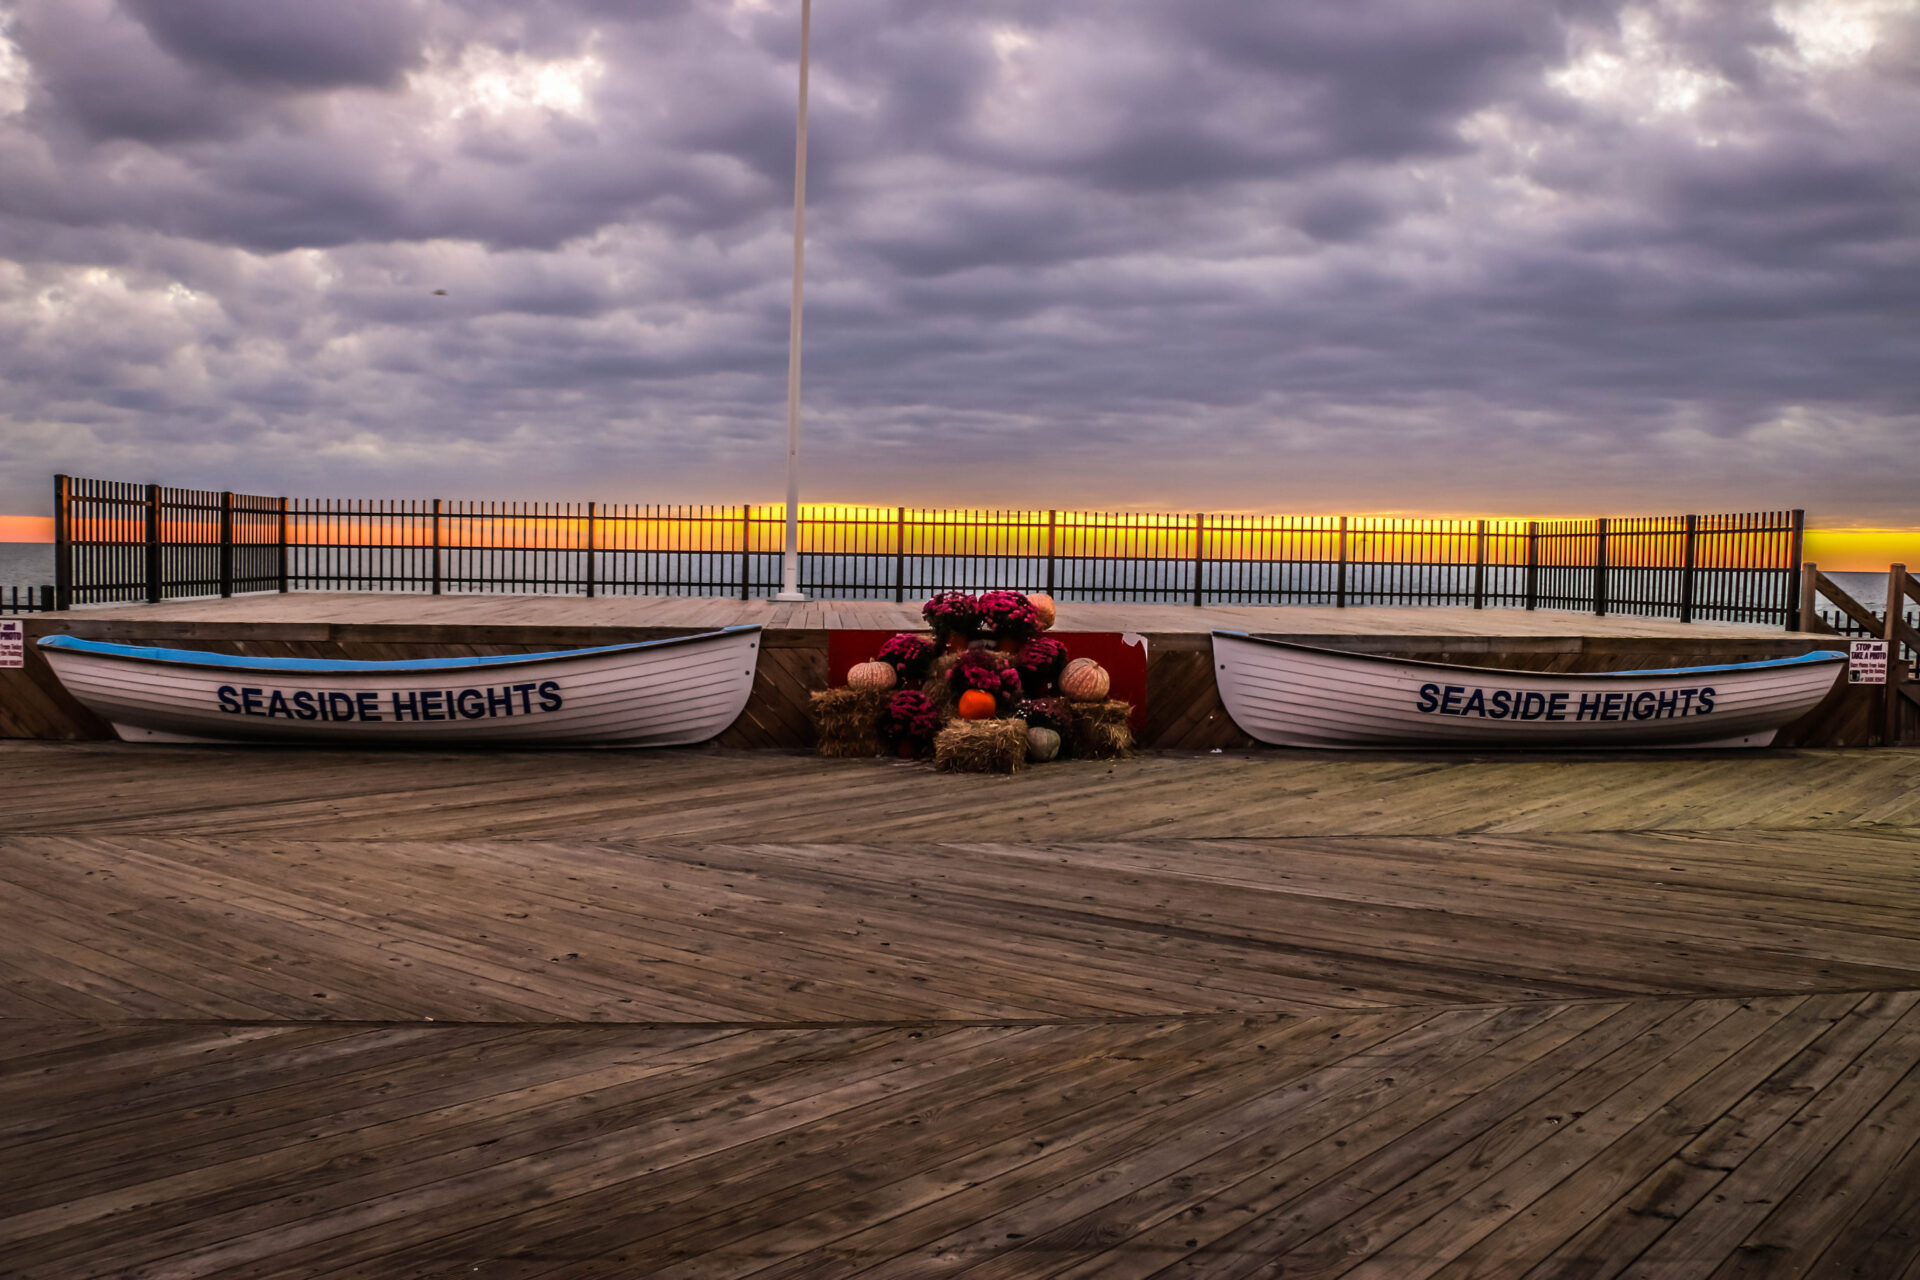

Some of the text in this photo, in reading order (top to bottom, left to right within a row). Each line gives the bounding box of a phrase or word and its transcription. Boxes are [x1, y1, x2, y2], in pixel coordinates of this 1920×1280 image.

[1856, 643, 1882, 651] STOP and
[217, 681, 563, 722] SEASIDE HEIGHTS
[1416, 683, 1716, 721] SEASIDE HEIGHTS
